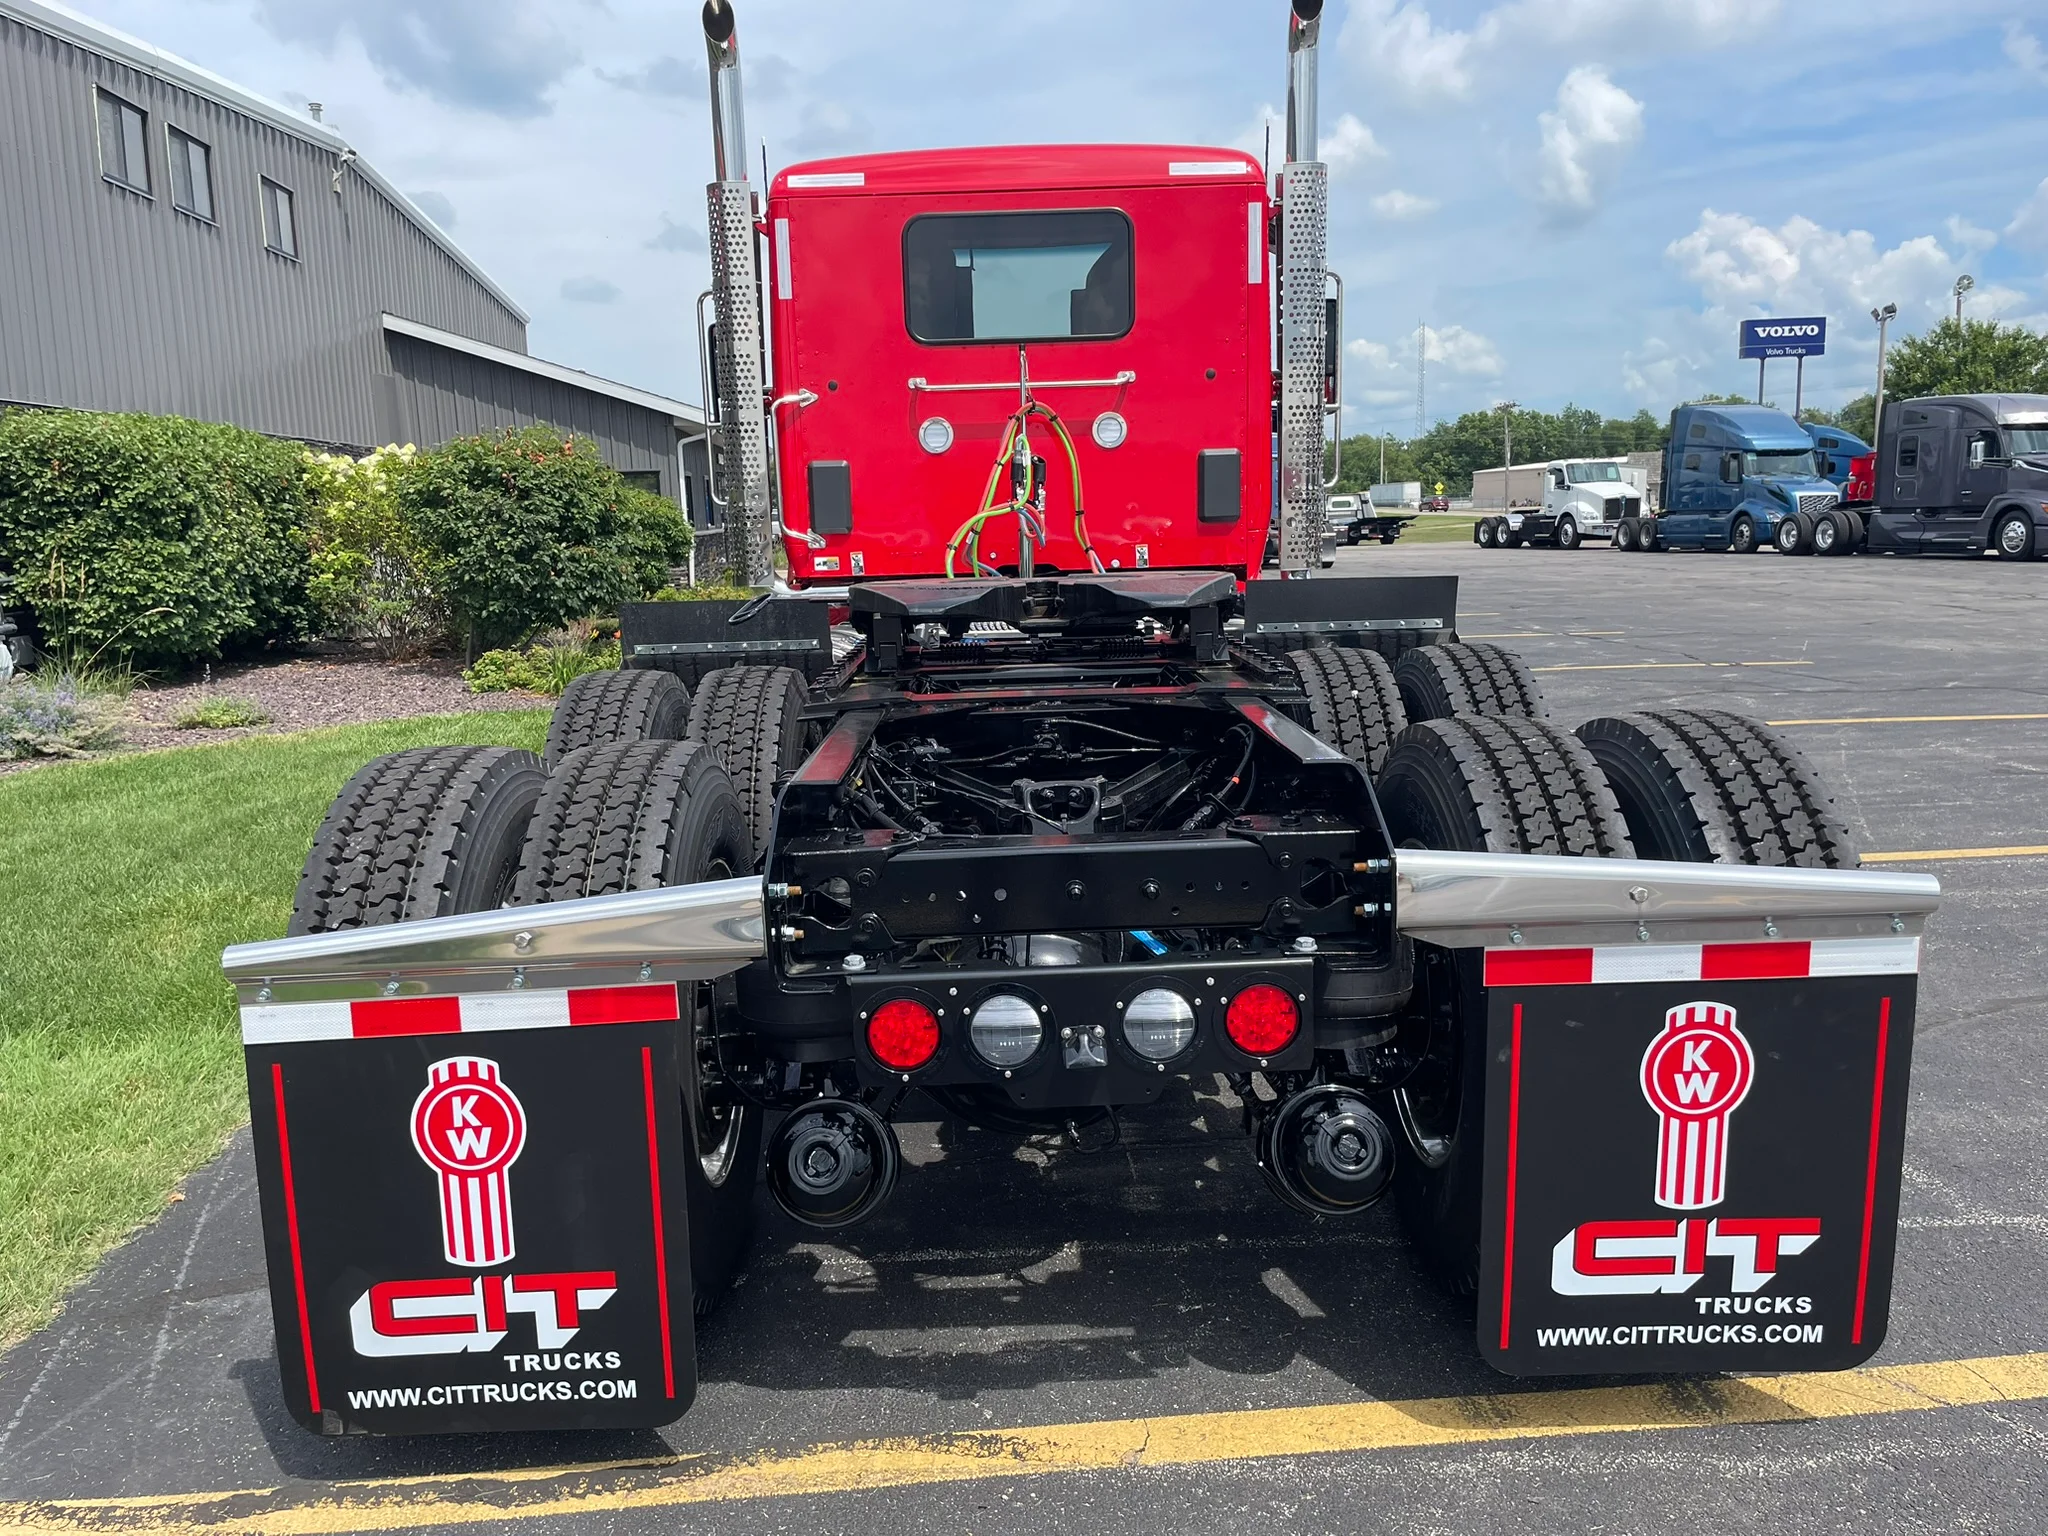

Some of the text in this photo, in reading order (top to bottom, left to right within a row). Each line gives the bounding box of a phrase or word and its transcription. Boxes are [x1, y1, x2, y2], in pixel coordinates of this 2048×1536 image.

[1754, 325, 1819, 338] VOLVO
[1765, 347, 1806, 356] Volvo Trucks
[1551, 1217, 1821, 1295] CIT
[350, 1271, 618, 1357] CIT
[1694, 1296, 1812, 1315] TRUCKS
[1536, 1324, 1823, 1348] WWW.CITTRUCKS.COM
[503, 1351, 622, 1373] TRUCKS
[347, 1379, 638, 1410] WWW.CITTRUCKS.COM
